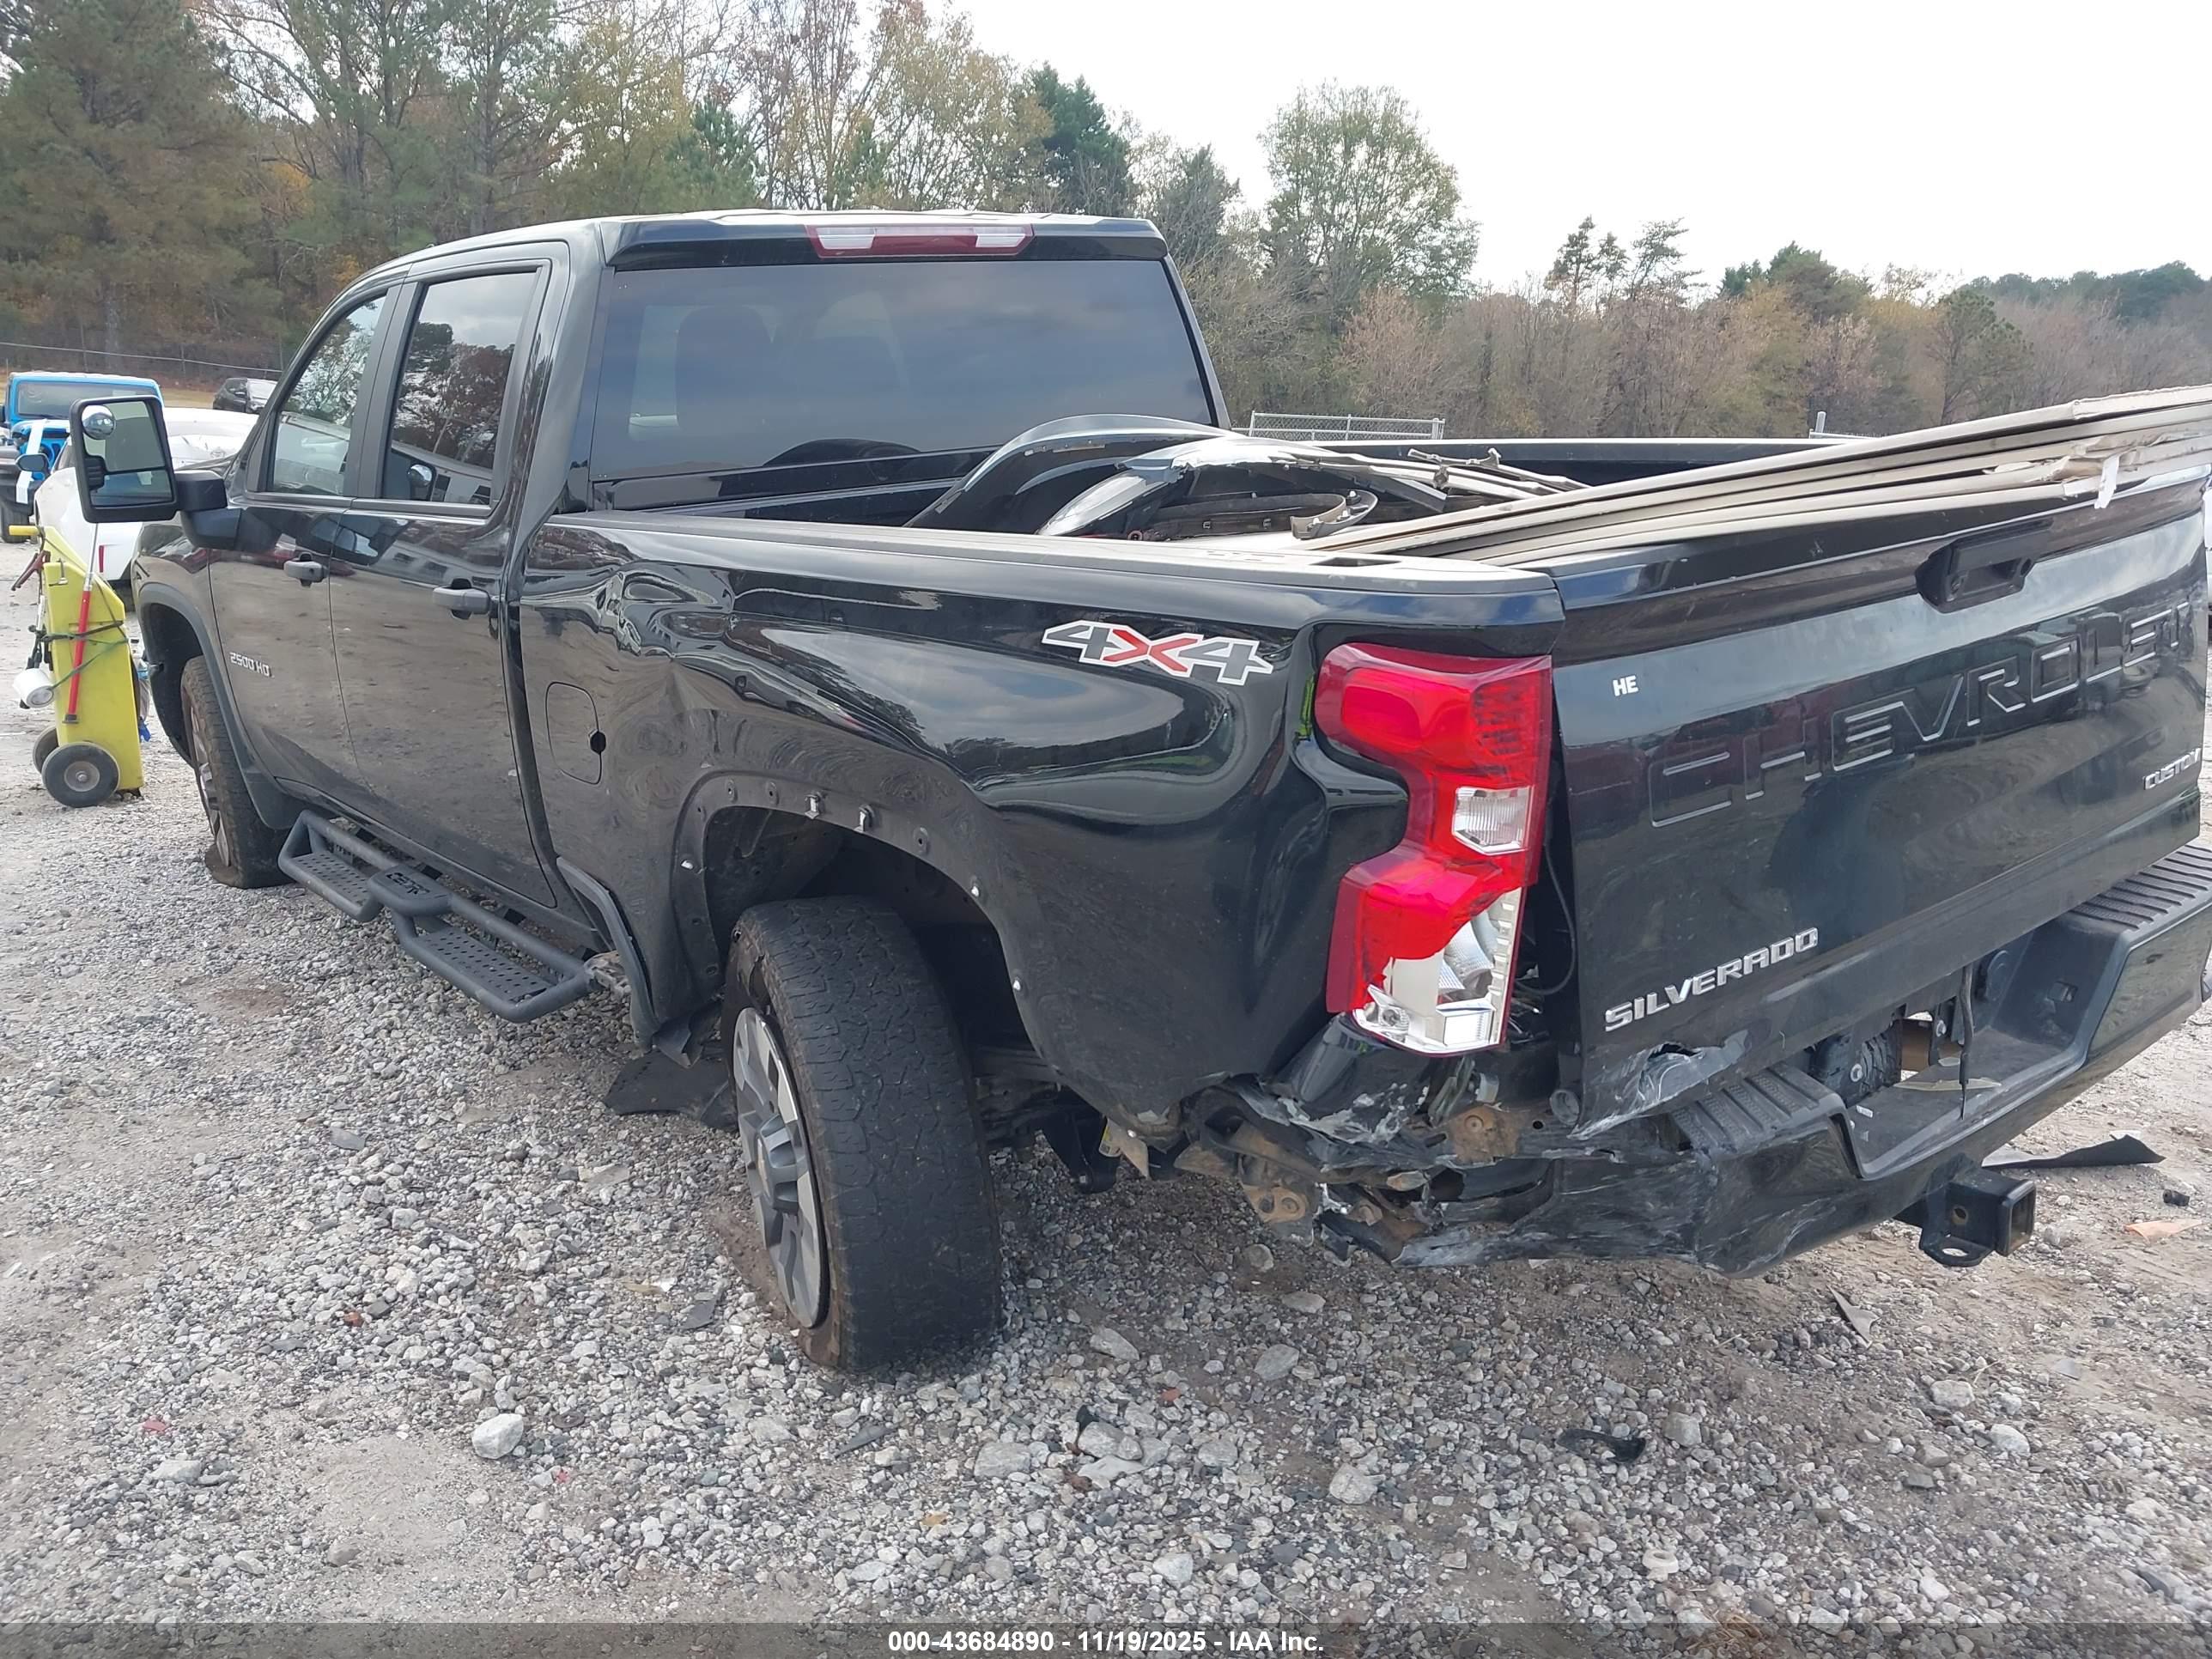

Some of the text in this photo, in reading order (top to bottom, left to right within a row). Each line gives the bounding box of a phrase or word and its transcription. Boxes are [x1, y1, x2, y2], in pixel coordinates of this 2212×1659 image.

[229, 652, 270, 677] 2500 HD
[1613, 675, 1639, 696] HE
[2144, 747, 2202, 789] CUSTOM
[1605, 927, 1819, 1032] SILVERADO
